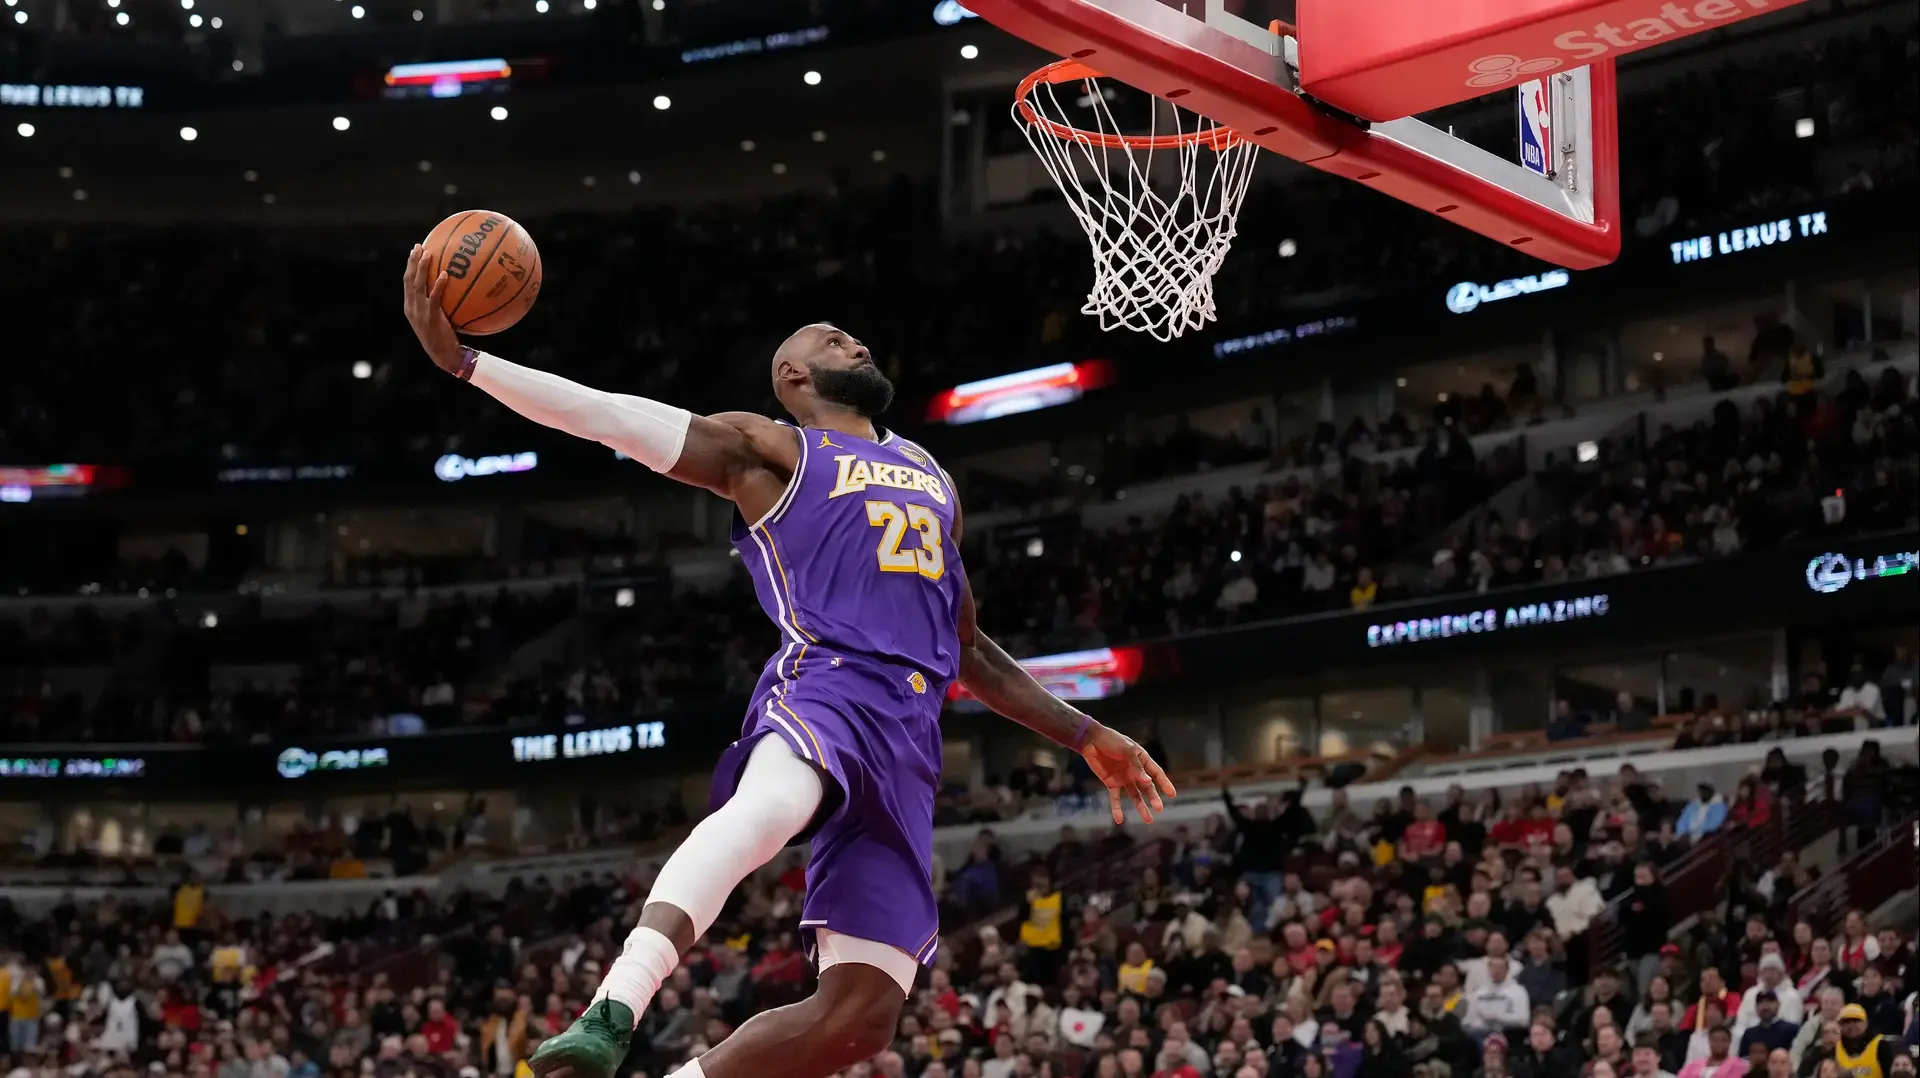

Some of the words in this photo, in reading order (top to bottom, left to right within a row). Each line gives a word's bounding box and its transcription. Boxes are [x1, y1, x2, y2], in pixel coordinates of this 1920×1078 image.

[1553, 0, 1742, 60] State
[1524, 142, 1540, 166] NBA
[447, 216, 503, 279] Wilson
[1670, 236, 1712, 264] THE
[1719, 218, 1791, 254] LEXUS
[1798, 211, 1827, 237] TX
[828, 454, 947, 505] LAKERS
[864, 500, 945, 581] 23
[1367, 609, 1497, 648] EXPERIENCE
[1504, 594, 1610, 628] AMAZING
[511, 734, 557, 762] THE
[563, 725, 632, 758] LEXUS
[636, 721, 665, 748] TX
